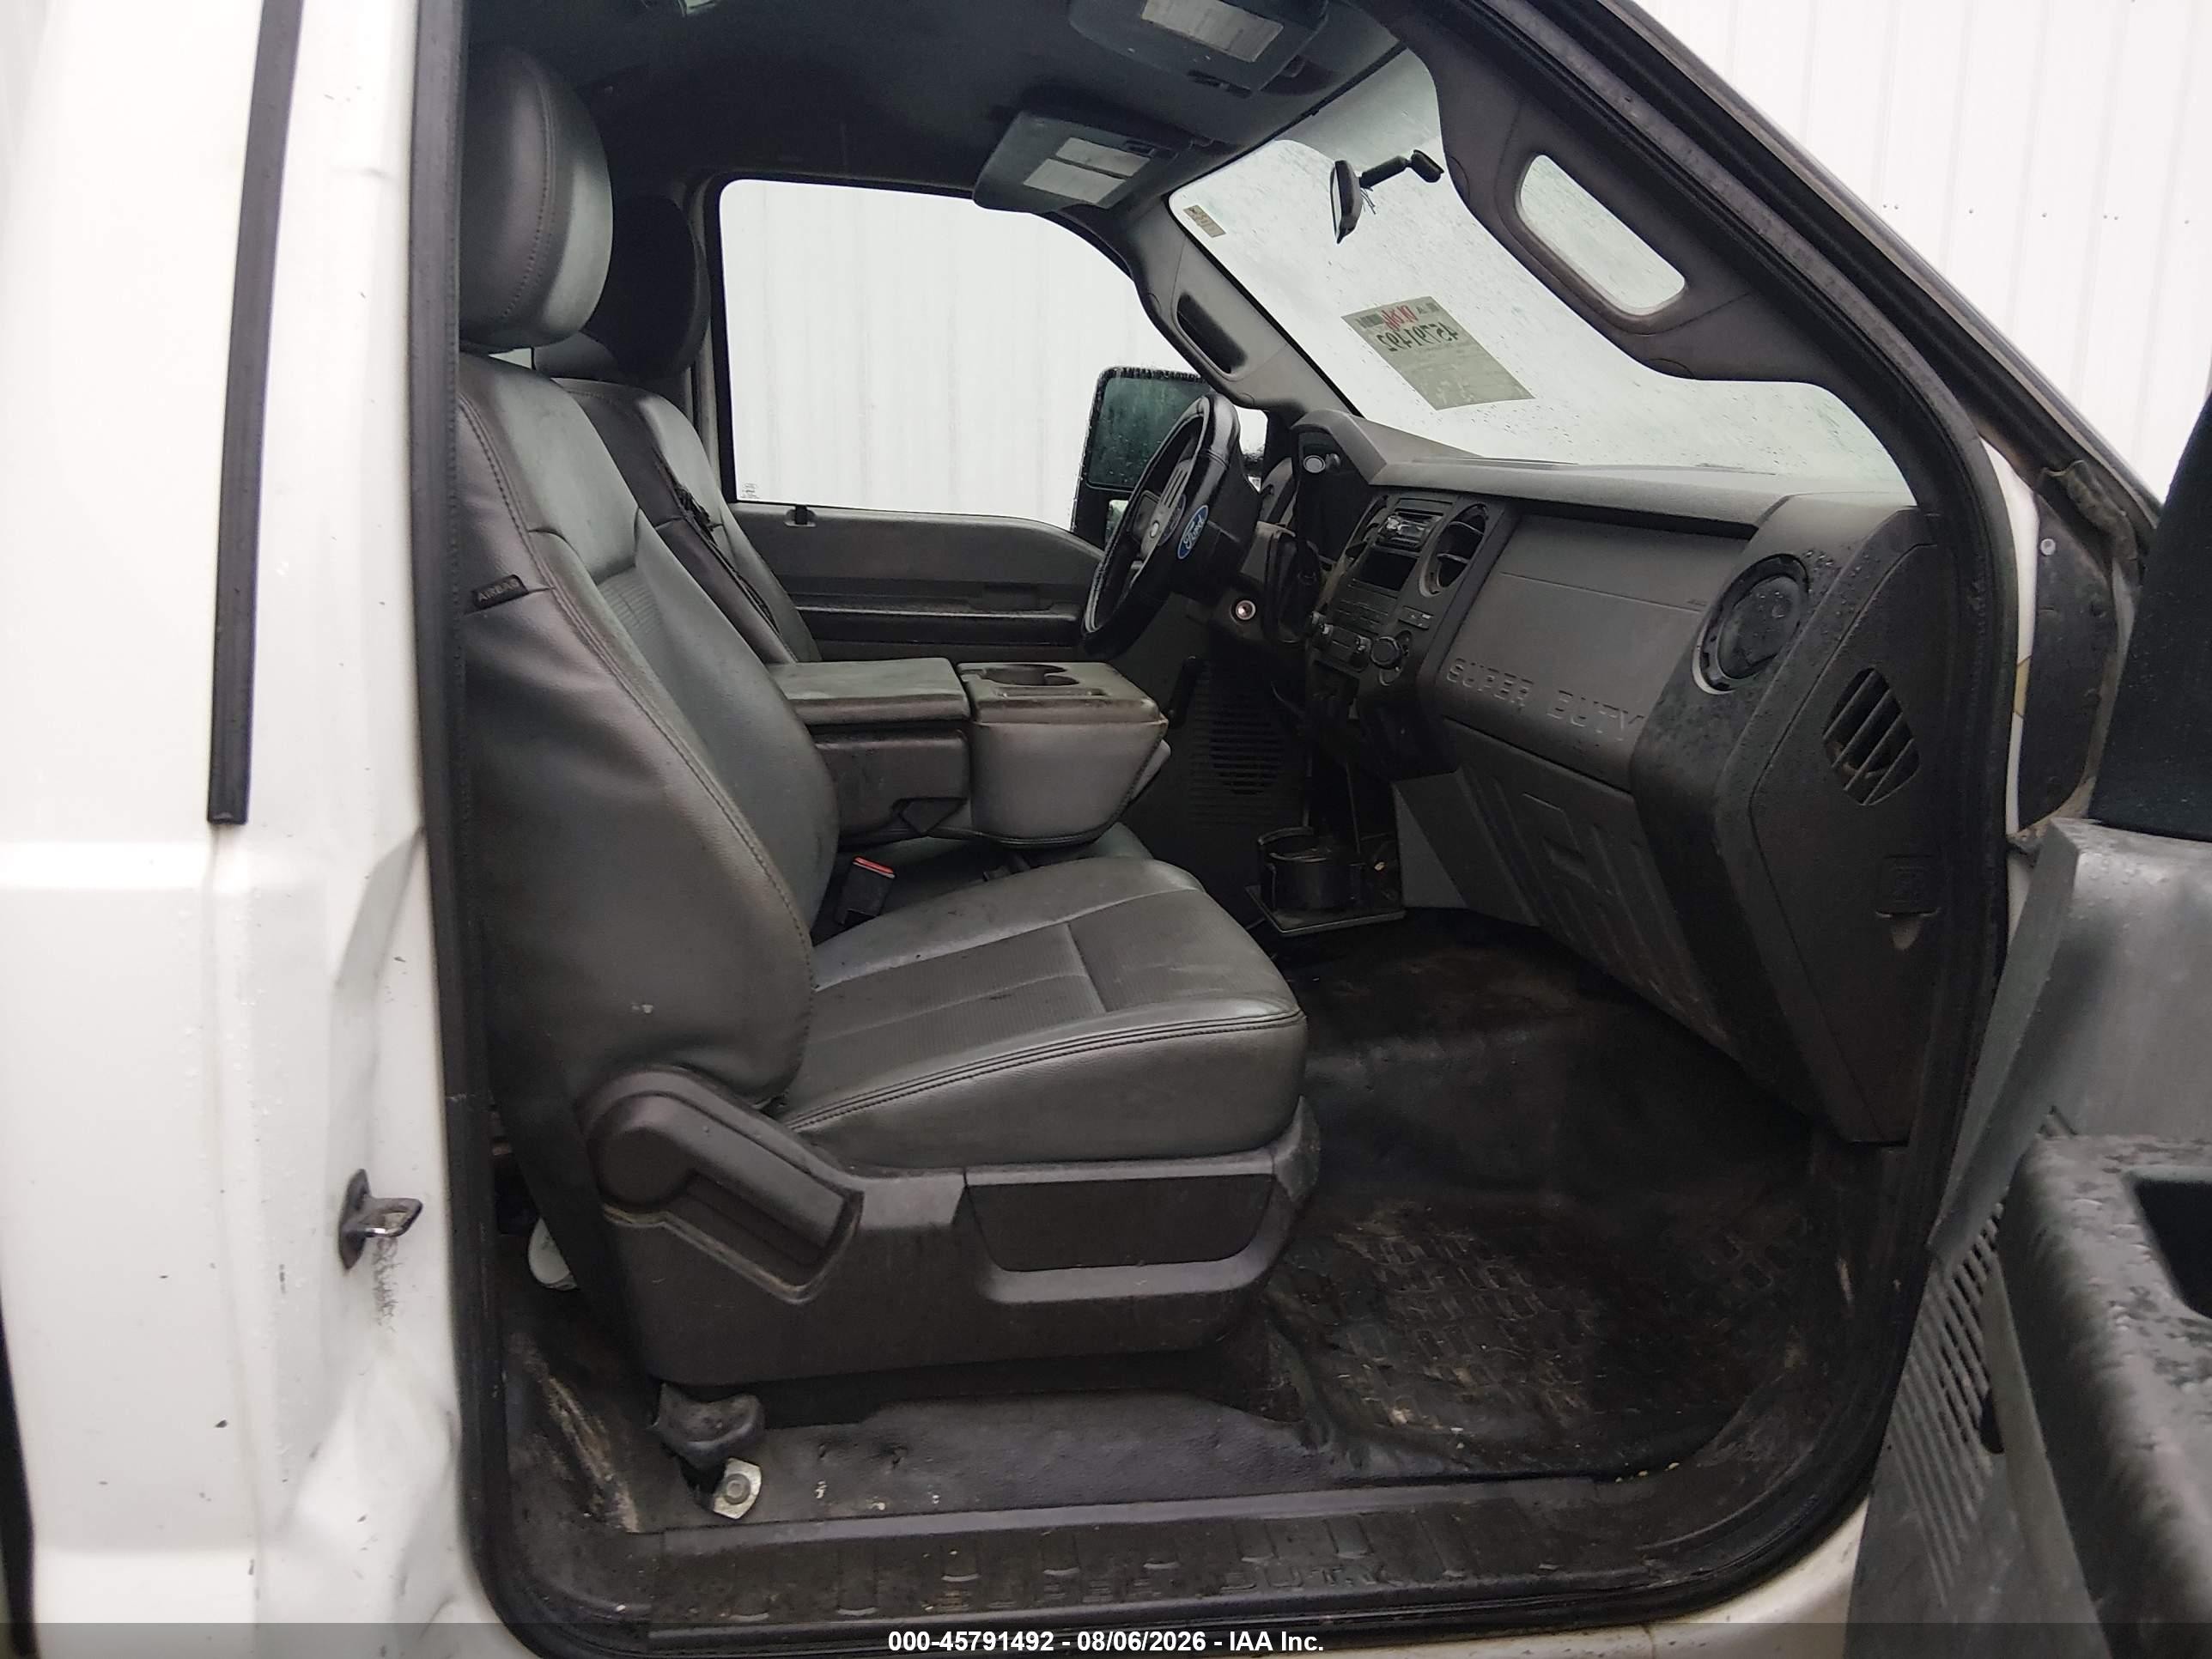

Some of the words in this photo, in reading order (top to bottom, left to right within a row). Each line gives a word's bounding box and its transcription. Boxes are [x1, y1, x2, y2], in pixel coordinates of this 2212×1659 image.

[1182, 514, 1205, 550] Ford
[1446, 657, 1535, 708] SUPER
[1546, 689, 1646, 742] DUTY
